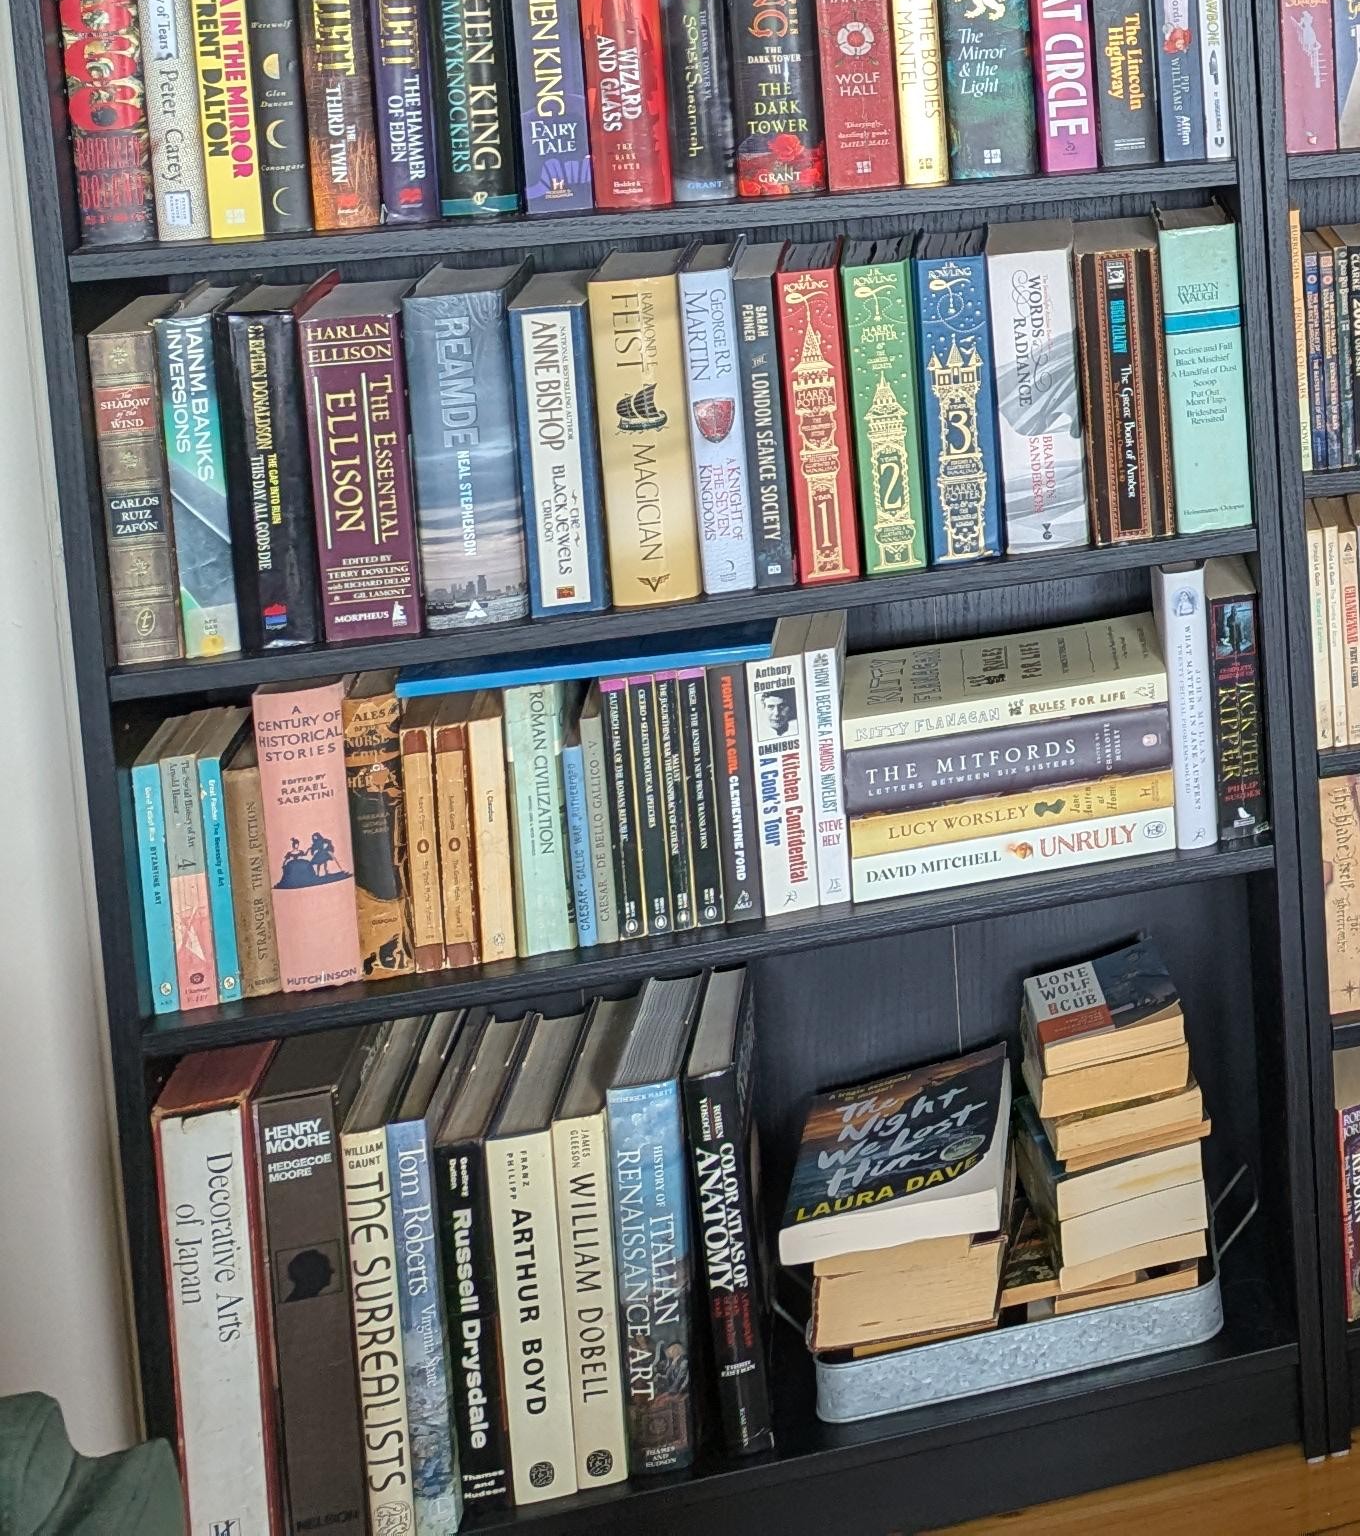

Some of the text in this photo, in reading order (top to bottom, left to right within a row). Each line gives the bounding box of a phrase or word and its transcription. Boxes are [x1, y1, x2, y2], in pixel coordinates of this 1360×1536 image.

[220, 6, 241, 37] IN
[224, 40, 247, 82] THE
[533, 47, 565, 119] KING
[836, 74, 882, 96] WOLF HALL
[1043, 33, 1088, 138] CIRCLE
[200, 68, 229, 158] DALTON
[226, 85, 255, 179] MIRROR
[530, 121, 577, 153] FAIRY TALE
[306, 322, 391, 361] HARLAN ELLISON
[434, 316, 479, 449] REAMDE
[110, 497, 160, 534] CARLOS RUIZ ZAFÓN
[456, 449, 478, 557] NEAL STEPHENSON
[632, 443, 664, 562] MAGICIAN
[258, 705, 341, 733] A CENTURY OF
[259, 728, 343, 748] HISTORICAL
[265, 742, 337, 762] STORIES
[528, 685, 554, 855] ROMAN CIVILIZATION
[865, 739, 1077, 784] THE MITFORDS
[888, 805, 1029, 840] LUCY WORSLEY
[866, 824, 1136, 883] DAVID MITCHELL UNRULY
[287, 967, 357, 985] HUTCHINSON
[1035, 968, 1098, 1012] LONE WOLF CUB
[795, 1154, 978, 1222] LAURA DAVE
[172, 1204, 202, 1306] of Japan
[205, 1152, 241, 1343] Decorative Arts
[452, 1208, 487, 1450] Russell Drysdale
[511, 1209, 546, 1416] ARTHUR BOYD
